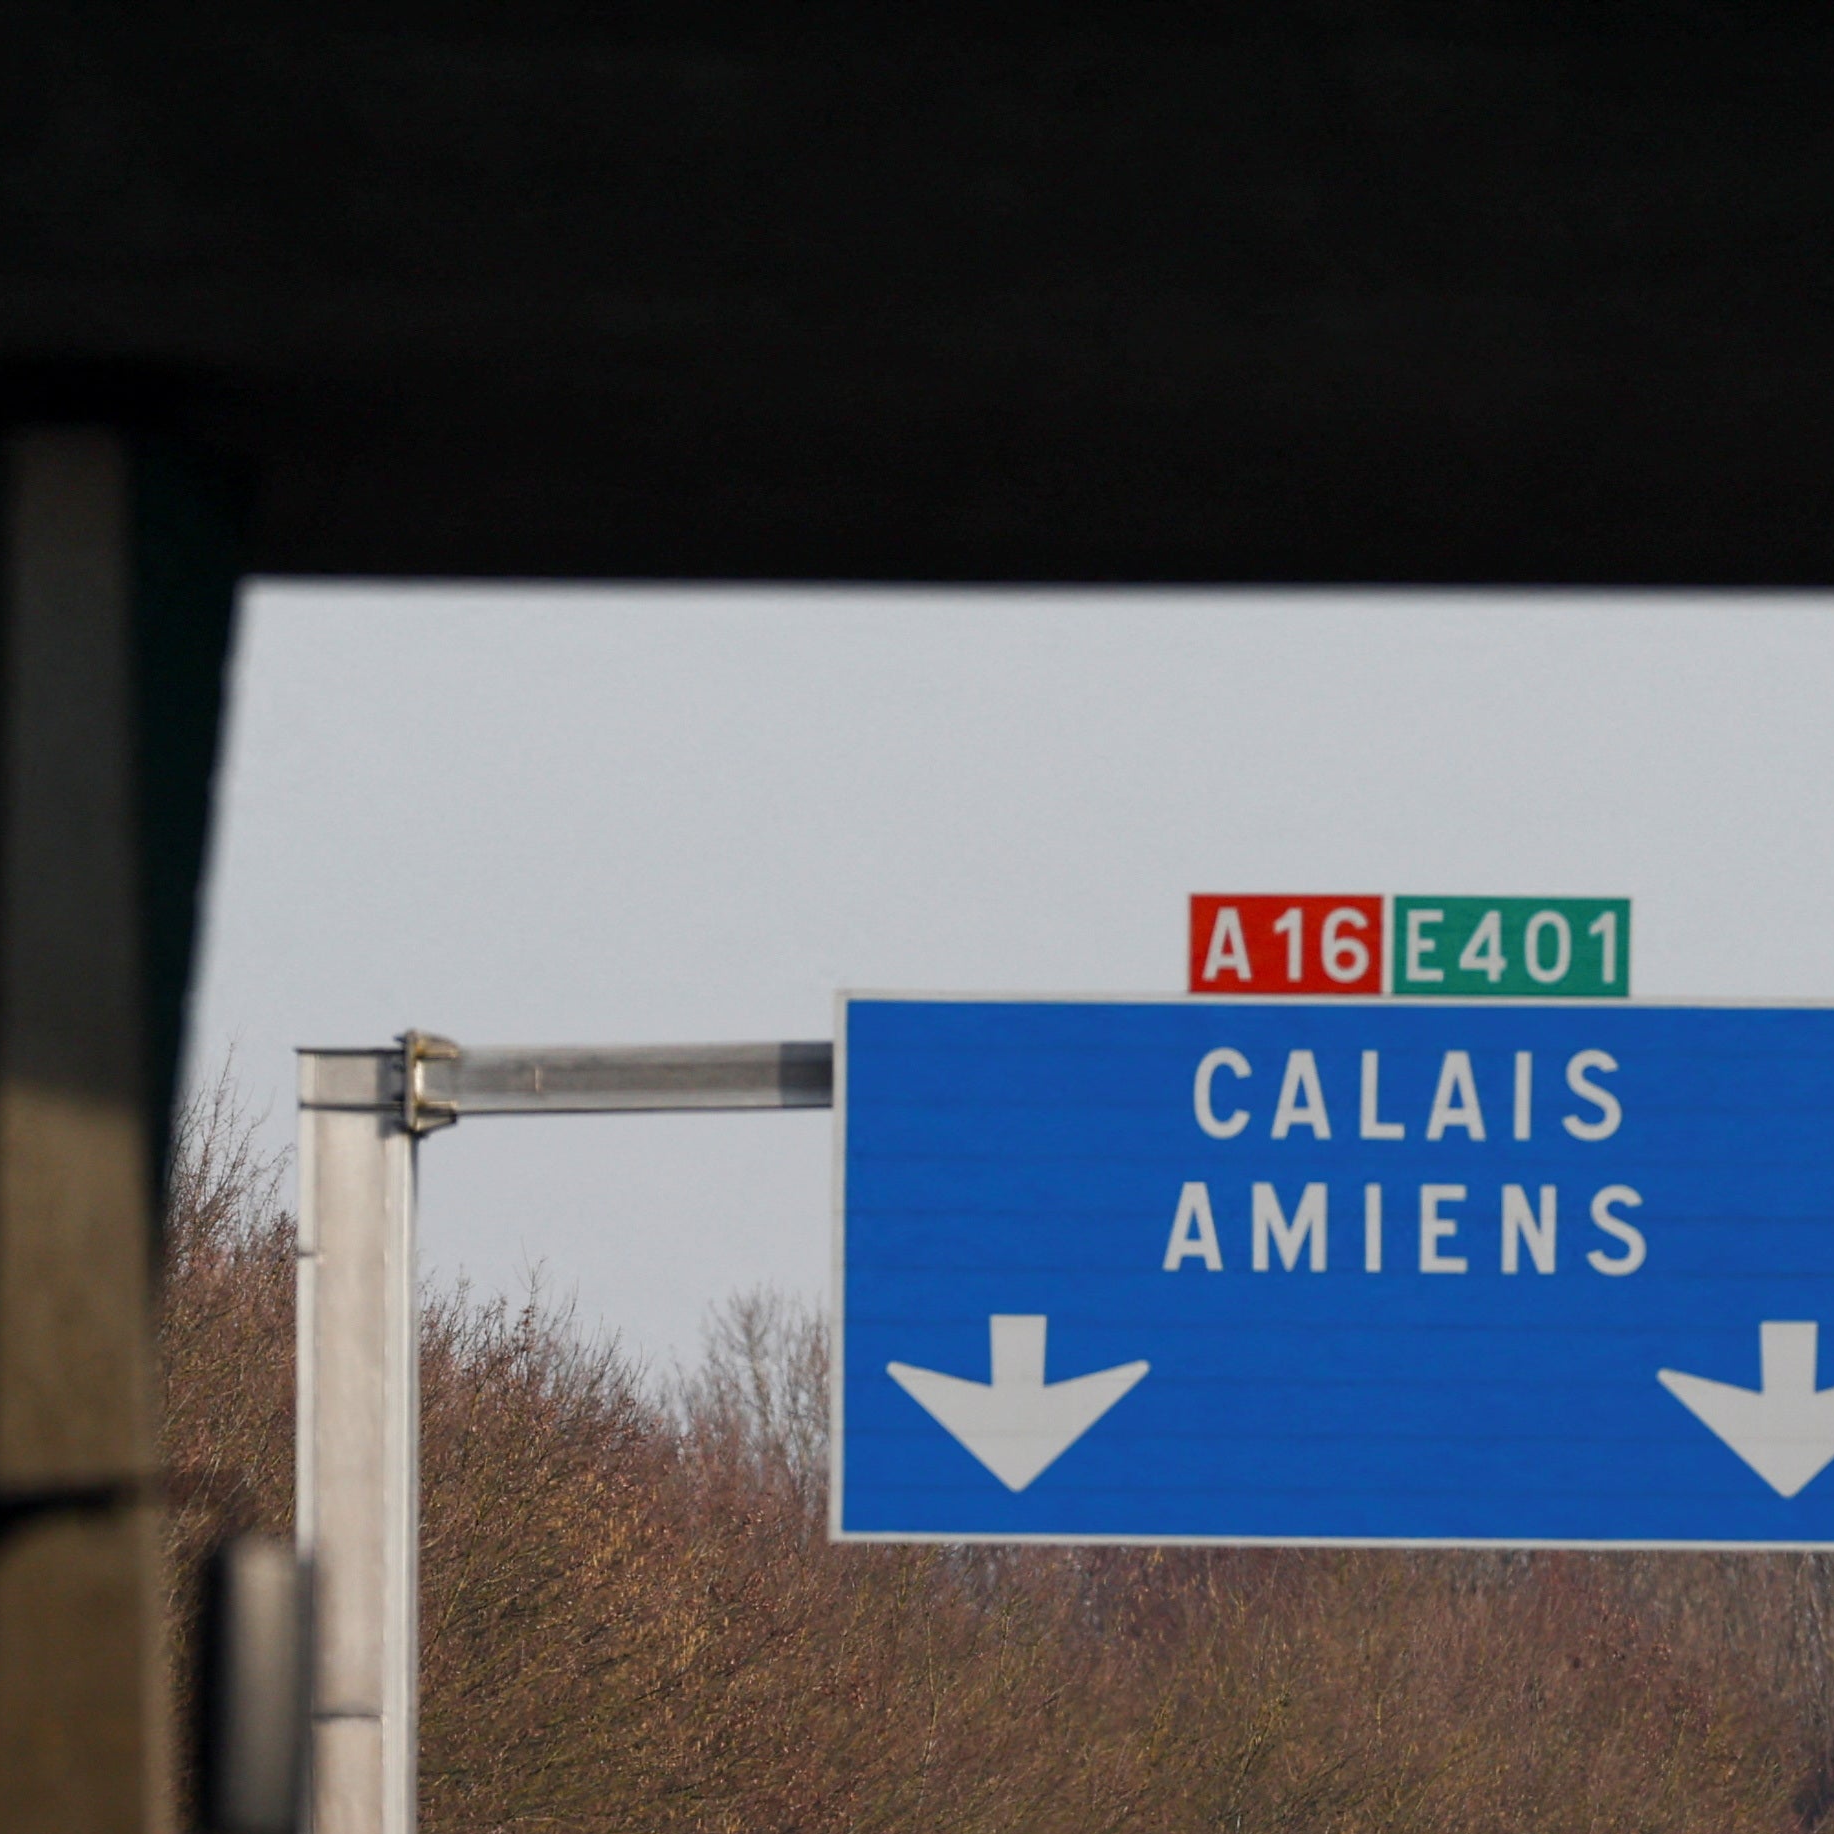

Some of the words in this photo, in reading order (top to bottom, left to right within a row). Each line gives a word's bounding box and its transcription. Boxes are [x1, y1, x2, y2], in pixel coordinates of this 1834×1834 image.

[1202, 906, 1369, 983] A16
[1405, 909, 1617, 984] E401
[1193, 1047, 1623, 1141] CALAIS
[1162, 1181, 1647, 1277] AMIENS
